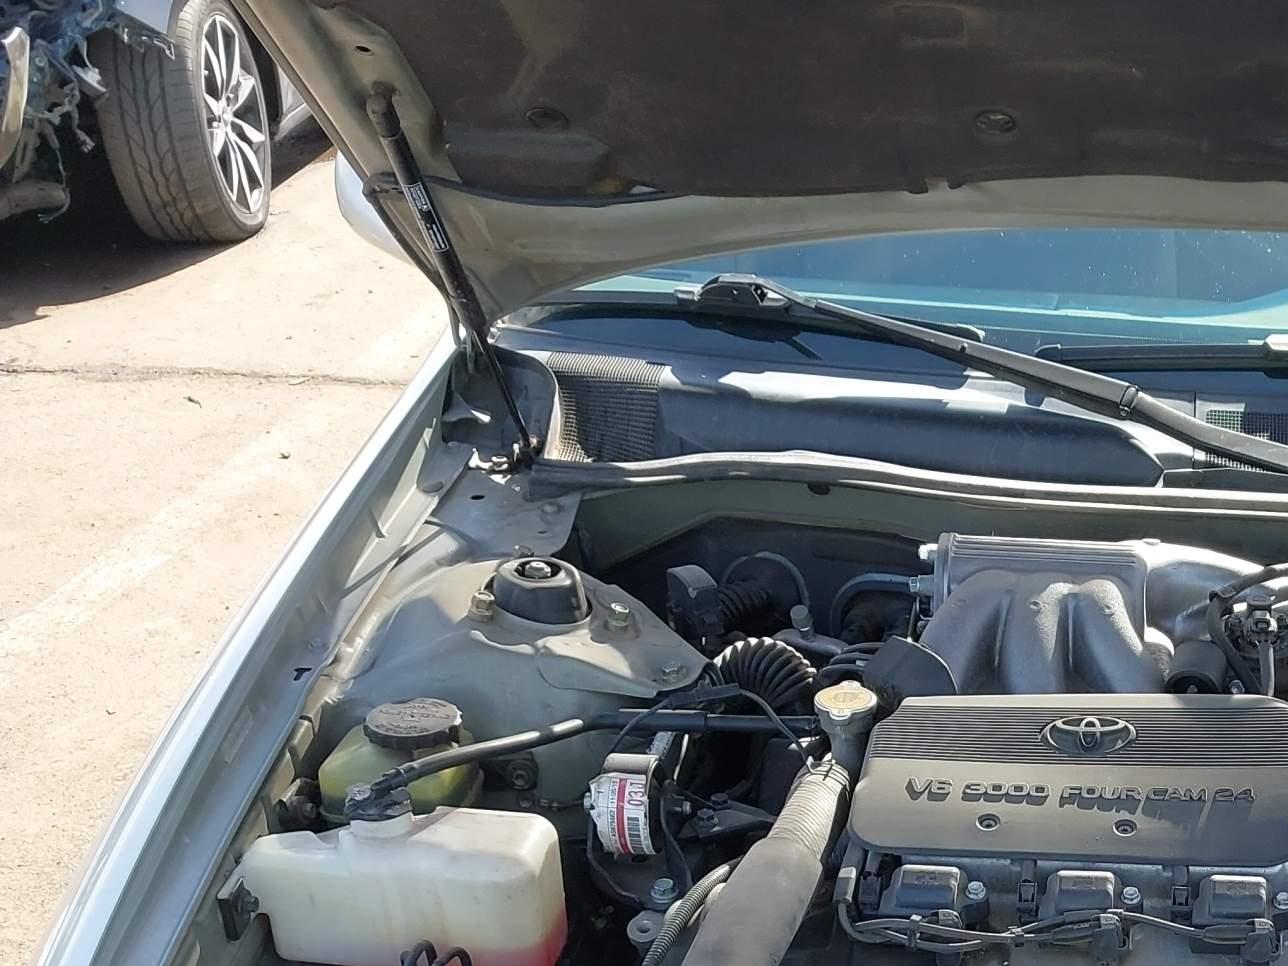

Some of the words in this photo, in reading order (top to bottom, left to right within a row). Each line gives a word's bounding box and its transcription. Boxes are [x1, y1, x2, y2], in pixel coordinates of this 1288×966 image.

[909, 776, 953, 794] V6
[964, 782, 1050, 798] 3000
[1062, 785, 1142, 801] FOUR
[1150, 786, 1207, 801] CAM
[1215, 787, 1256, 802] 24
